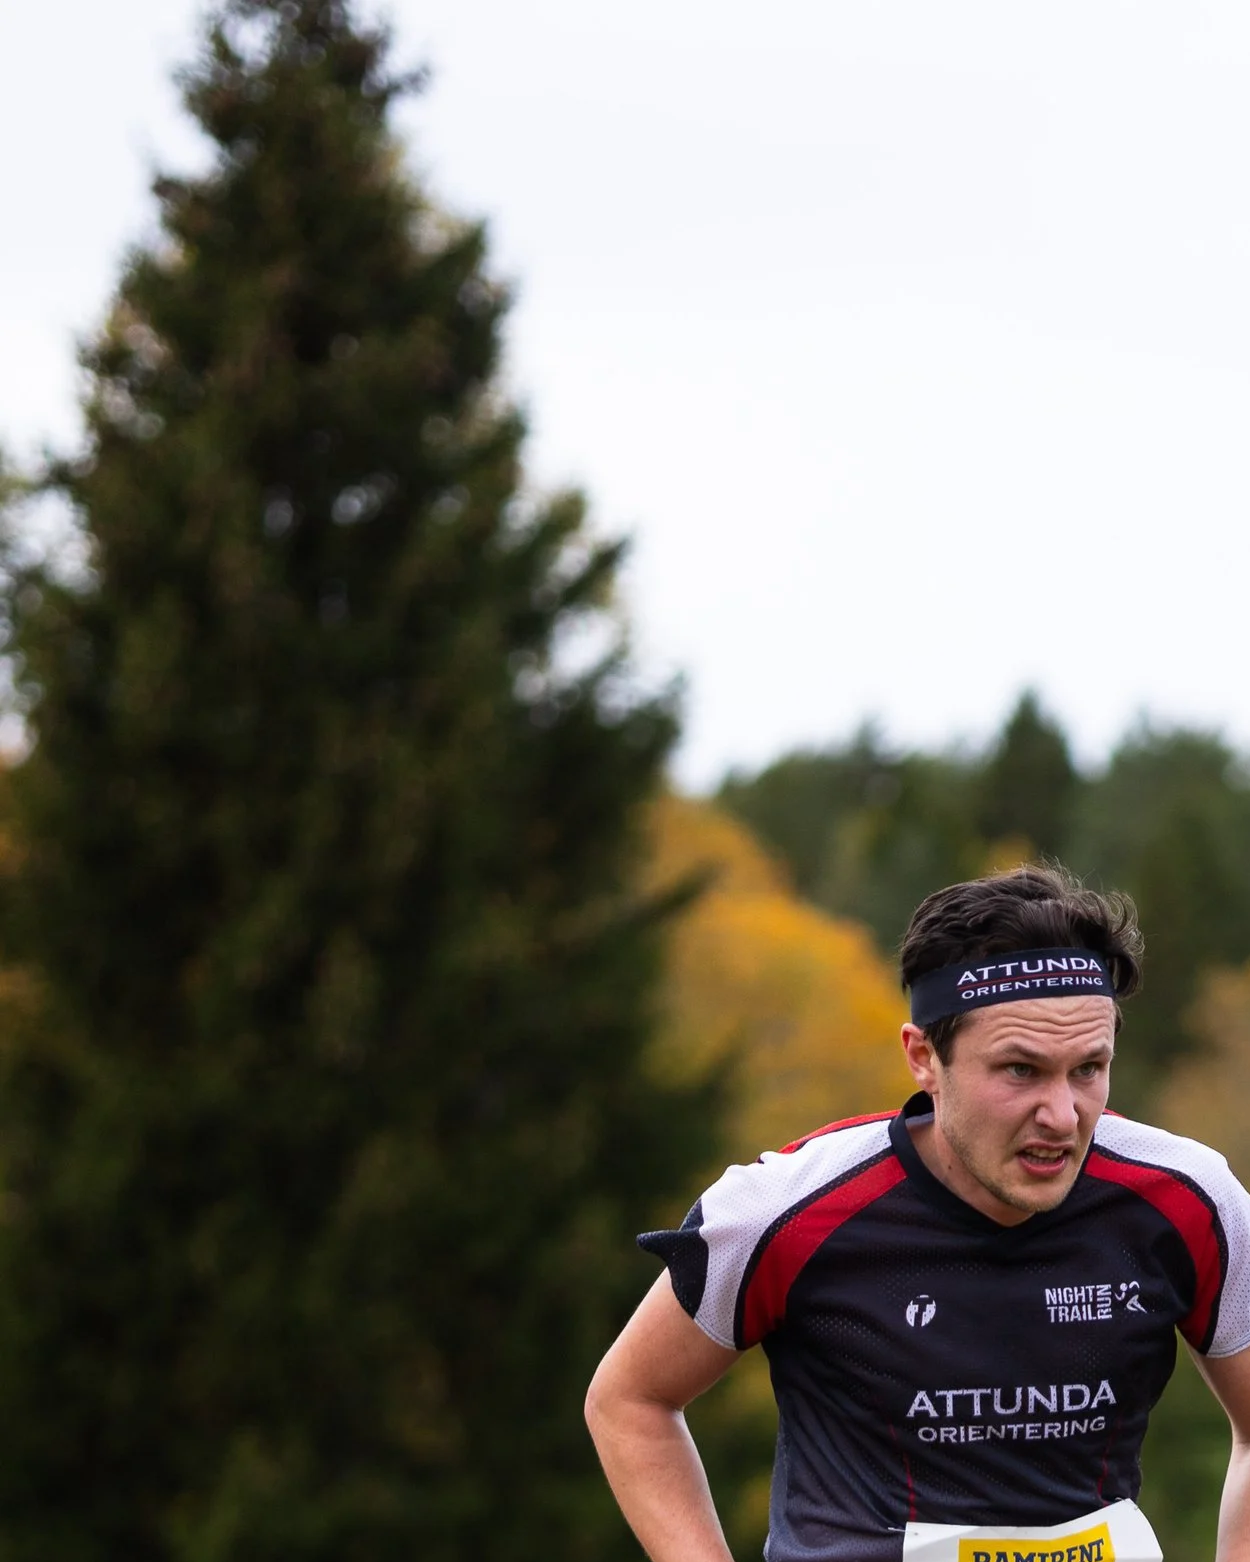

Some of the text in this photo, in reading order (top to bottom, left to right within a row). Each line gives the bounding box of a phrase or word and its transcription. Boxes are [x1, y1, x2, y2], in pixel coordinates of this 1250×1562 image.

[957, 957, 1102, 986] ATTUNDA
[961, 976, 1103, 1000] ORIENTERING
[1045, 1285, 1095, 1305] NIGHT
[1096, 1284, 1112, 1320] RUN
[1047, 1304, 1097, 1323] TRAIL
[906, 1380, 1117, 1418] ATTUNDA
[918, 1416, 1106, 1443] ORIENTERING
